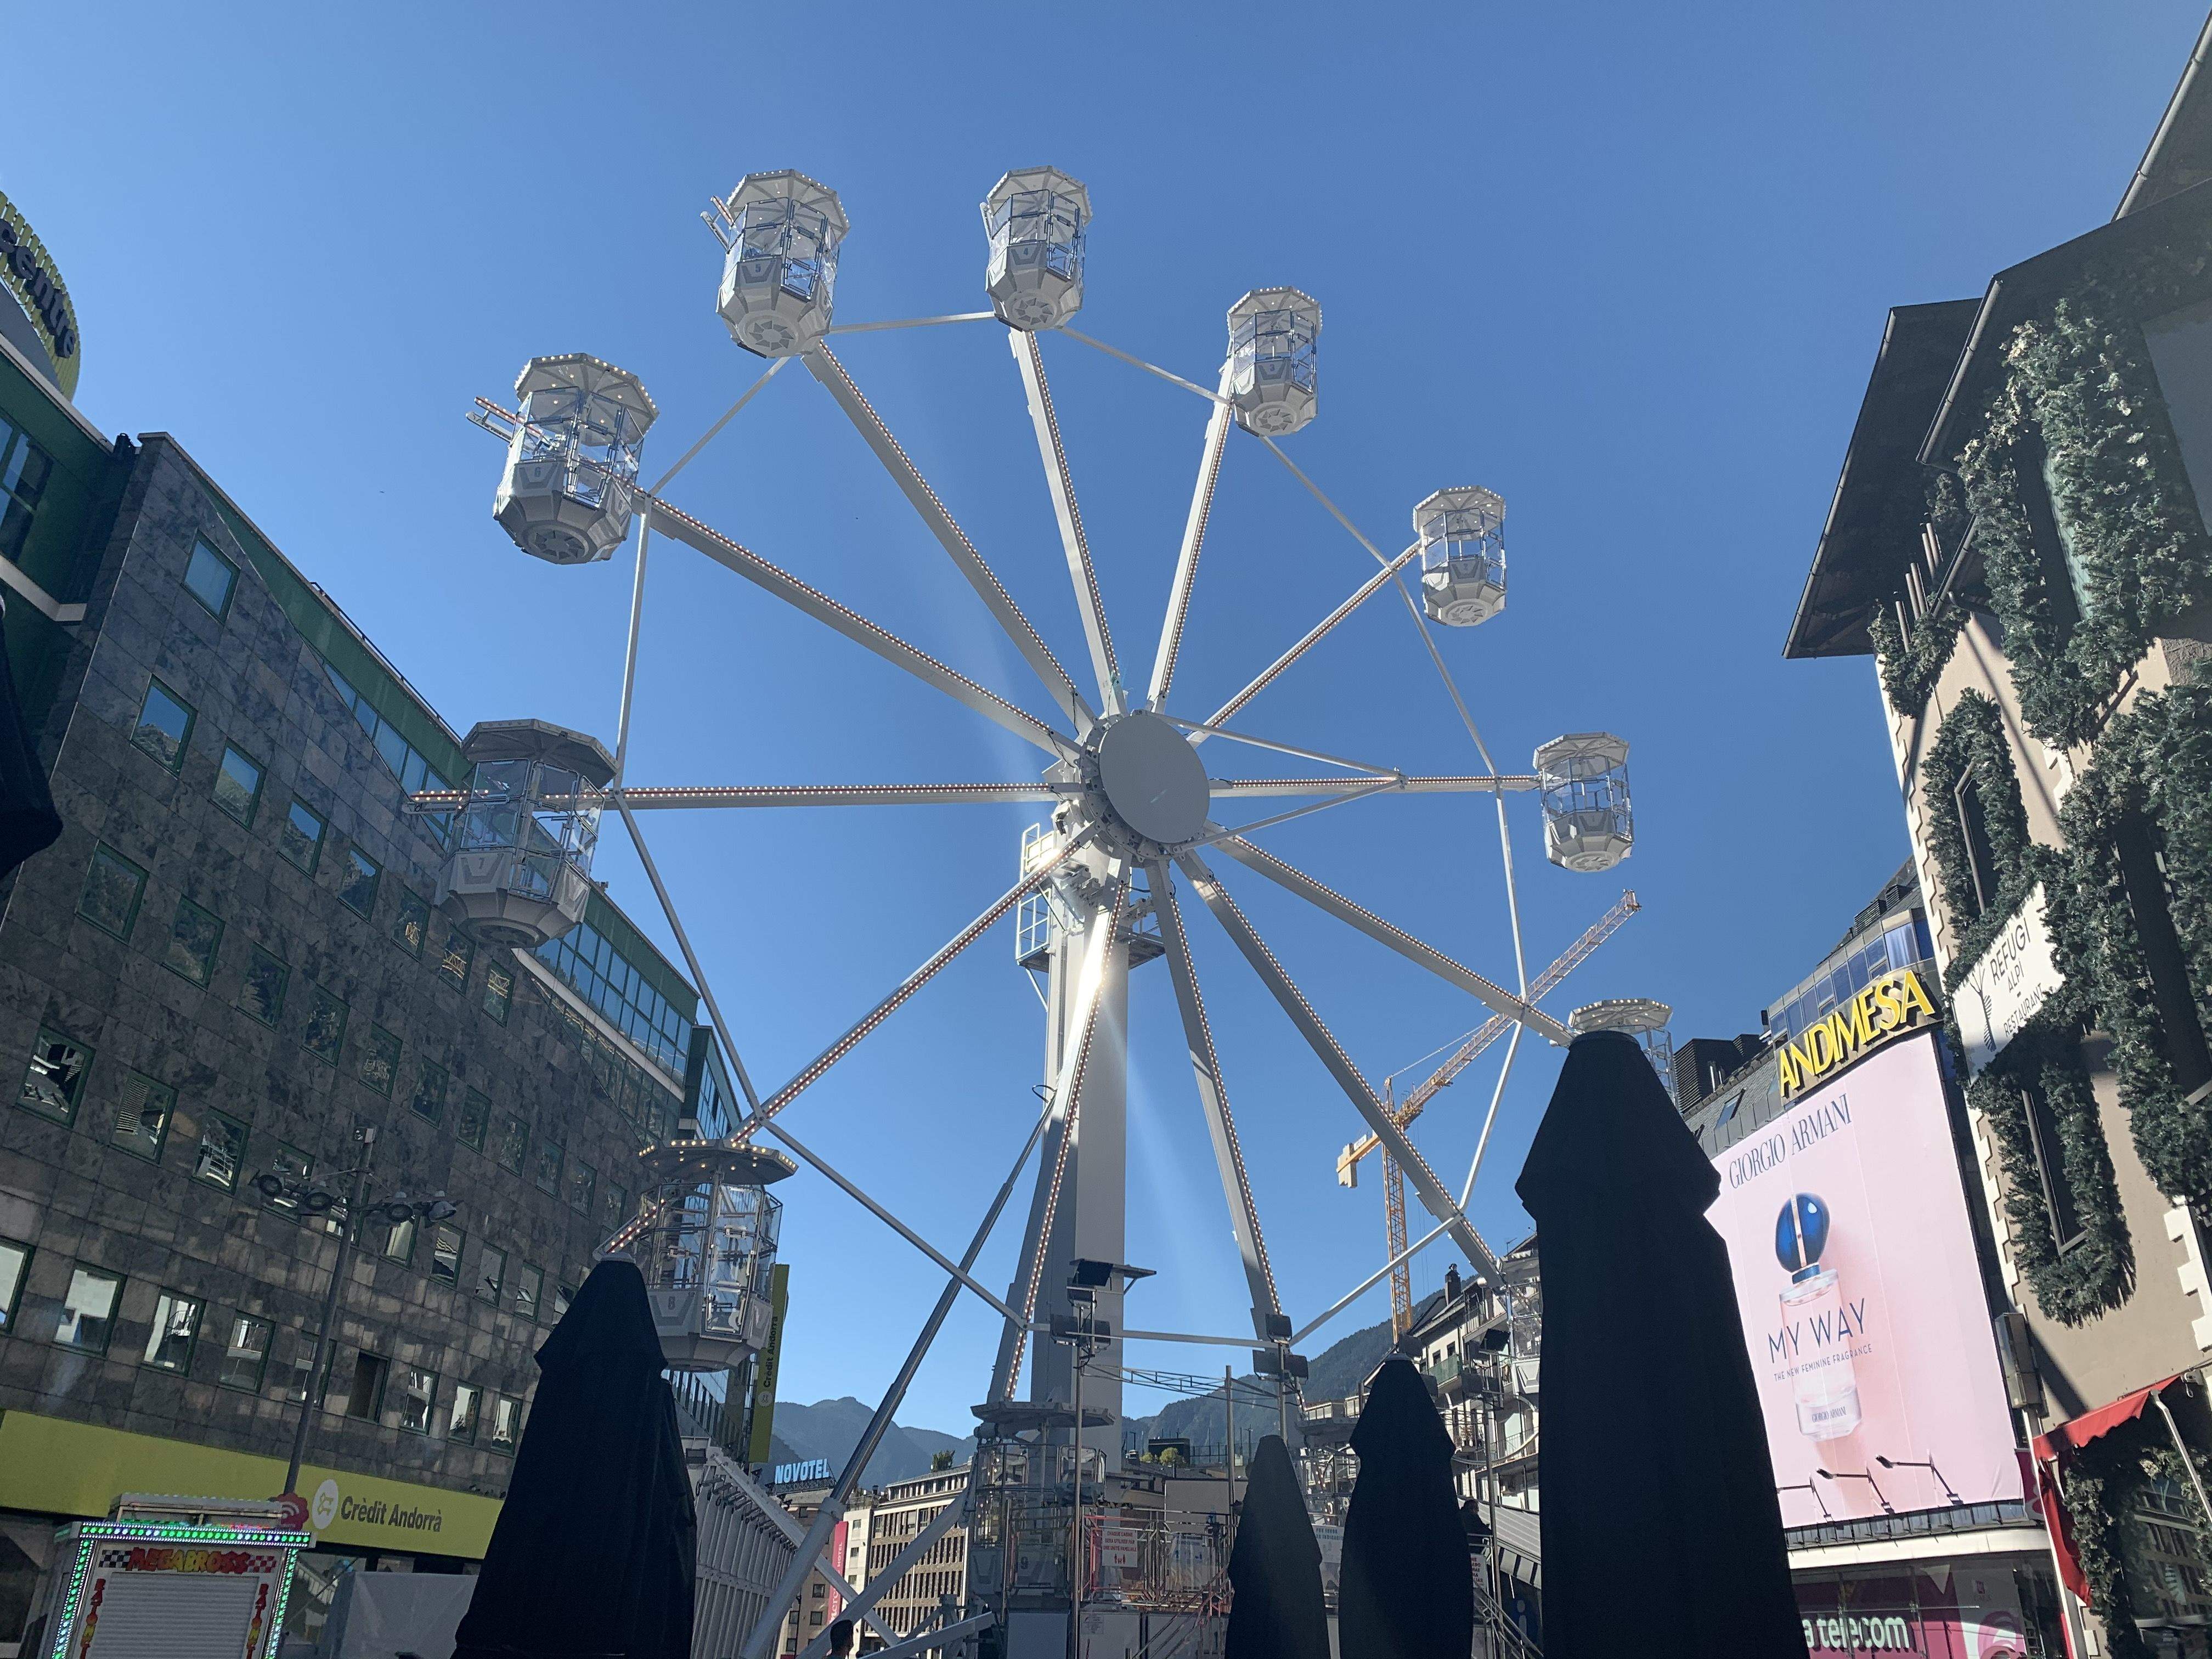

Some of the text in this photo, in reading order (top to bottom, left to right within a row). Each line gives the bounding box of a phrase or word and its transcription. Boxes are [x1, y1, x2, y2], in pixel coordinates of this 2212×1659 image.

[1024, 247, 1028, 256] 4
[755, 264, 761, 273] 5
[1269, 364, 1275, 372] 3
[534, 467, 541, 477] 6
[1990, 917, 2030, 985] REFUGI
[2004, 983, 2044, 1037] RESTAURANT
[1780, 969, 1936, 1097] ANDIMESA
[1729, 1093, 1852, 1189] GIORGIO ARMANI
[1768, 1297, 1865, 1364] MY WAY
[1774, 1344, 1873, 1382] THE NEW FEMININE FRAGRANCE
[1812, 1406, 1847, 1423] GIORGIO ARMANI
[774, 1458, 829, 1485] NOVOTEL
[340, 1496, 442, 1532] Crèdit Andorrà
[1020, 1556, 1029, 1570] 9
[1816, 1617, 1910, 1648] telecom
